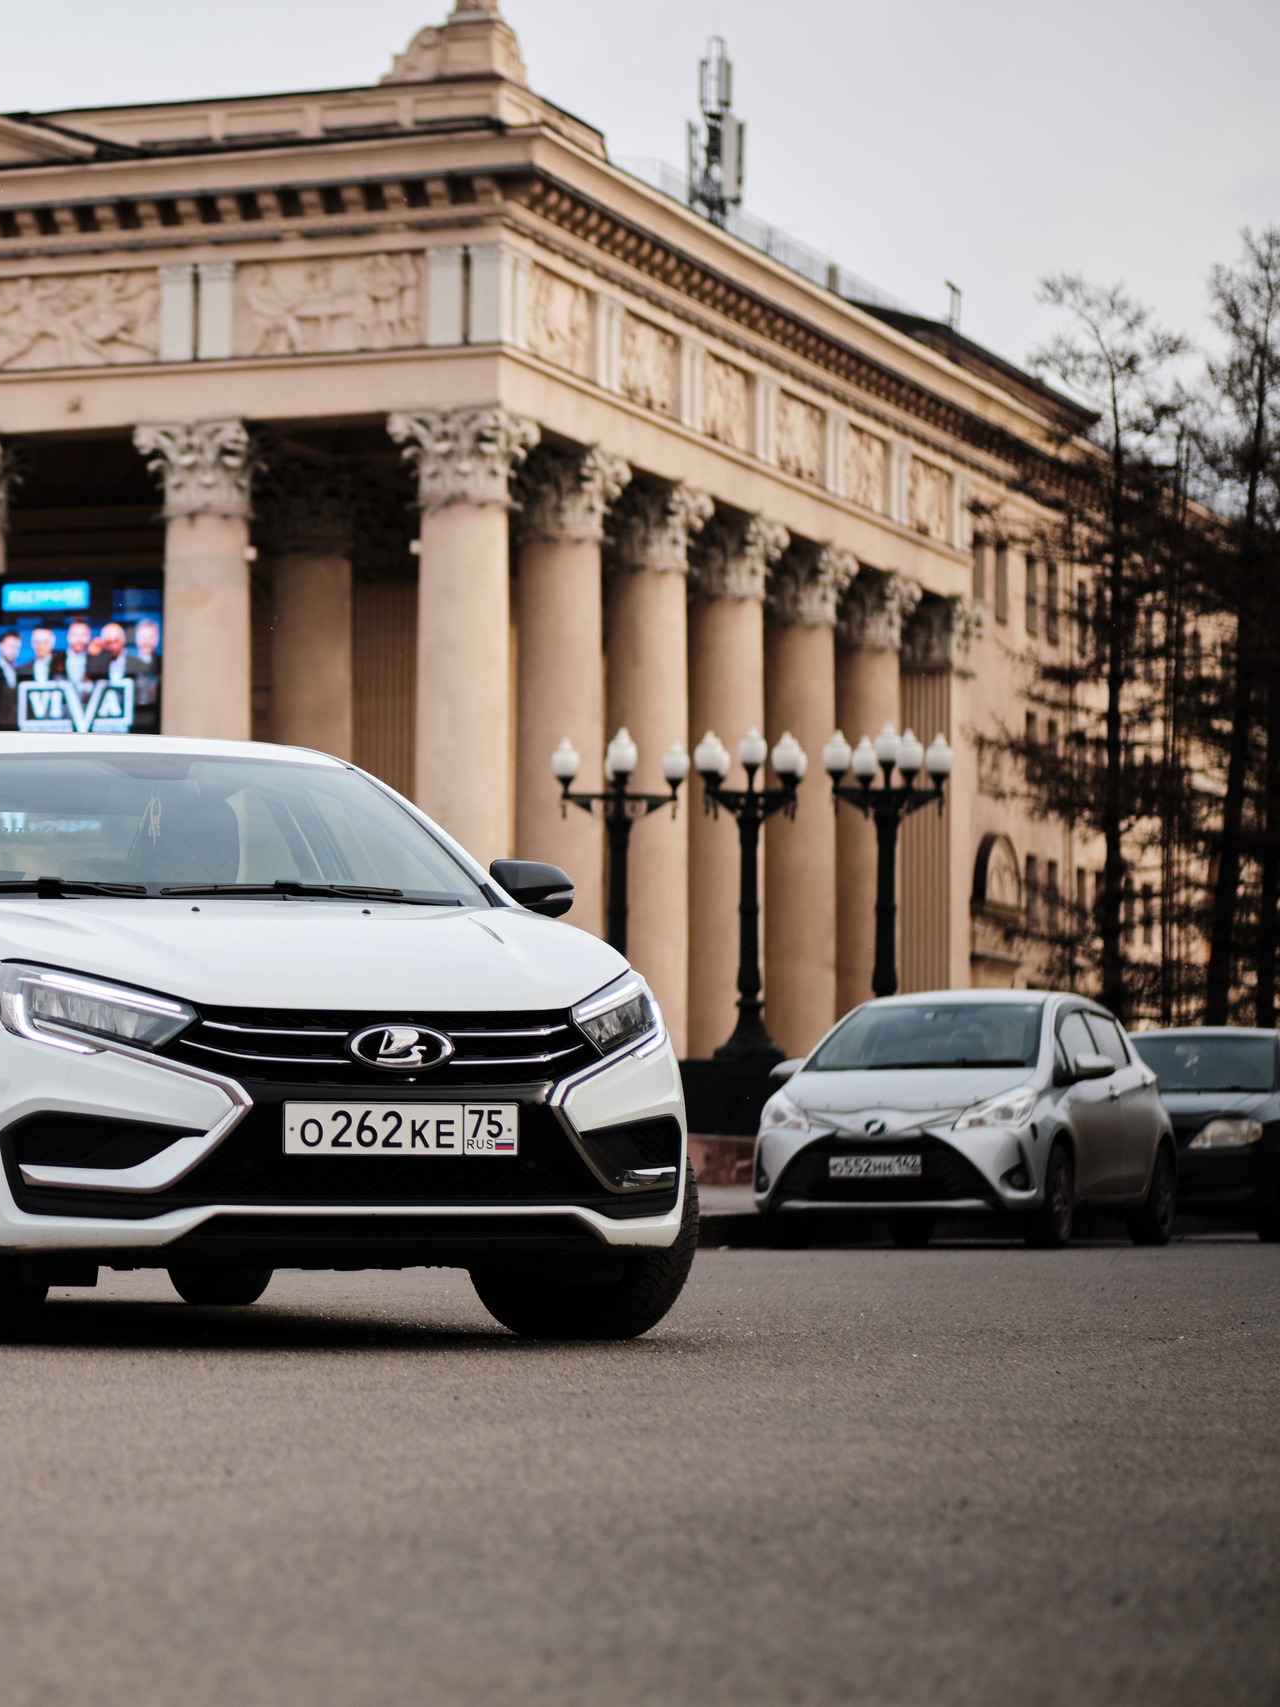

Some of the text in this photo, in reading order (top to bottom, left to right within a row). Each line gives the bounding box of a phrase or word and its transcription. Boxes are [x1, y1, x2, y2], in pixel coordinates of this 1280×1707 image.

[29, 680, 122, 733] VIVA
[300, 1109, 503, 1149] О262КЕ 75
[466, 1139, 494, 1150] RUS
